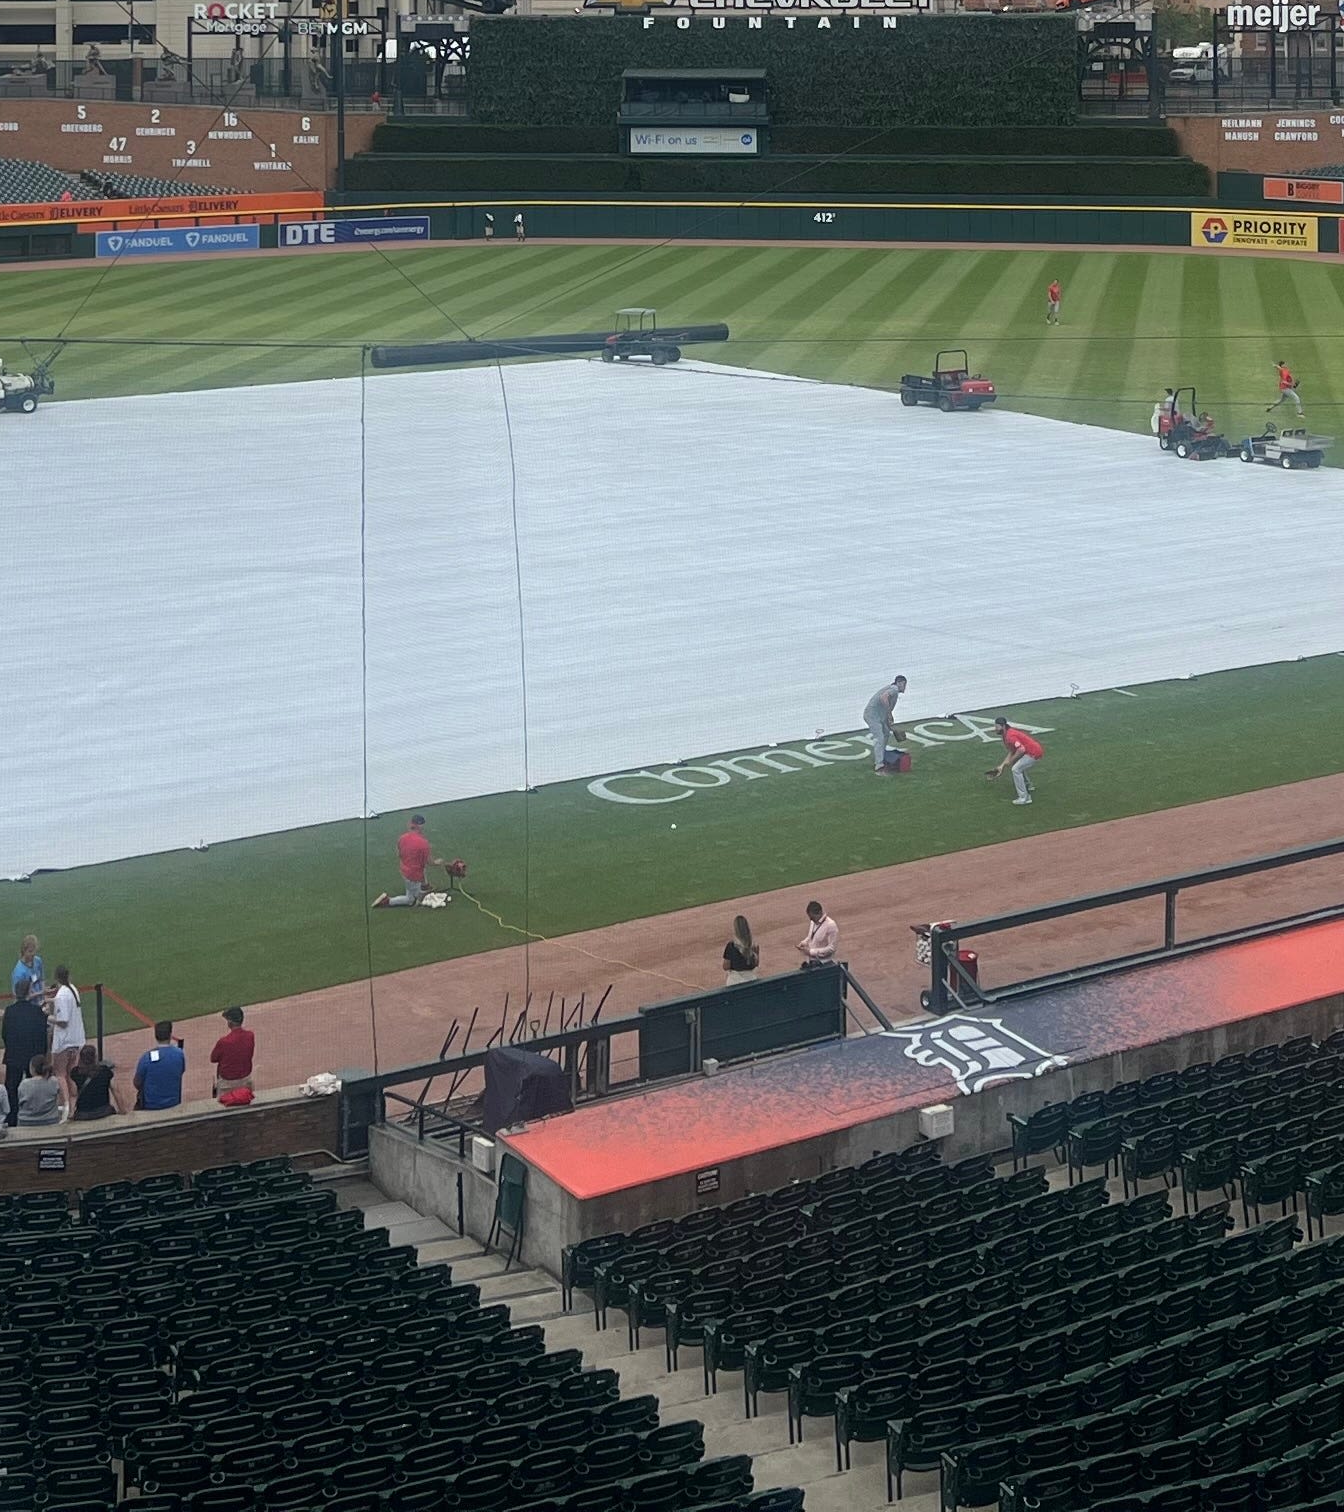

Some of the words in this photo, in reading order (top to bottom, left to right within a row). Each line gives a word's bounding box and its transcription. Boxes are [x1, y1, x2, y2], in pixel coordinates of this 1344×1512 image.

[194, 3, 279, 20] ROCKET
[206, 21, 267, 36] Mortgage
[297, 21, 368, 36] BETMGM
[642, 17, 898, 30] FOUNTAIN
[77, 105, 87, 120] 5
[151, 109, 161, 124] 2
[223, 112, 238, 127] 16
[301, 117, 311, 131] 6
[1275, 118, 1316, 128] JENNINGS
[293, 135, 320, 145] KALINE
[668, 136, 682, 145] on
[685, 135, 698, 145] us
[1224, 131, 1259, 141] MANUSH
[1274, 131, 1319, 141] CRAWFORD
[108, 137, 127, 151] 47
[186, 140, 197, 155] 3
[269, 143, 277, 157] 1
[285, 223, 336, 244] DTE
[1233, 219, 1307, 235] PRIORITY
[202, 231, 249, 244] FANDUEL
